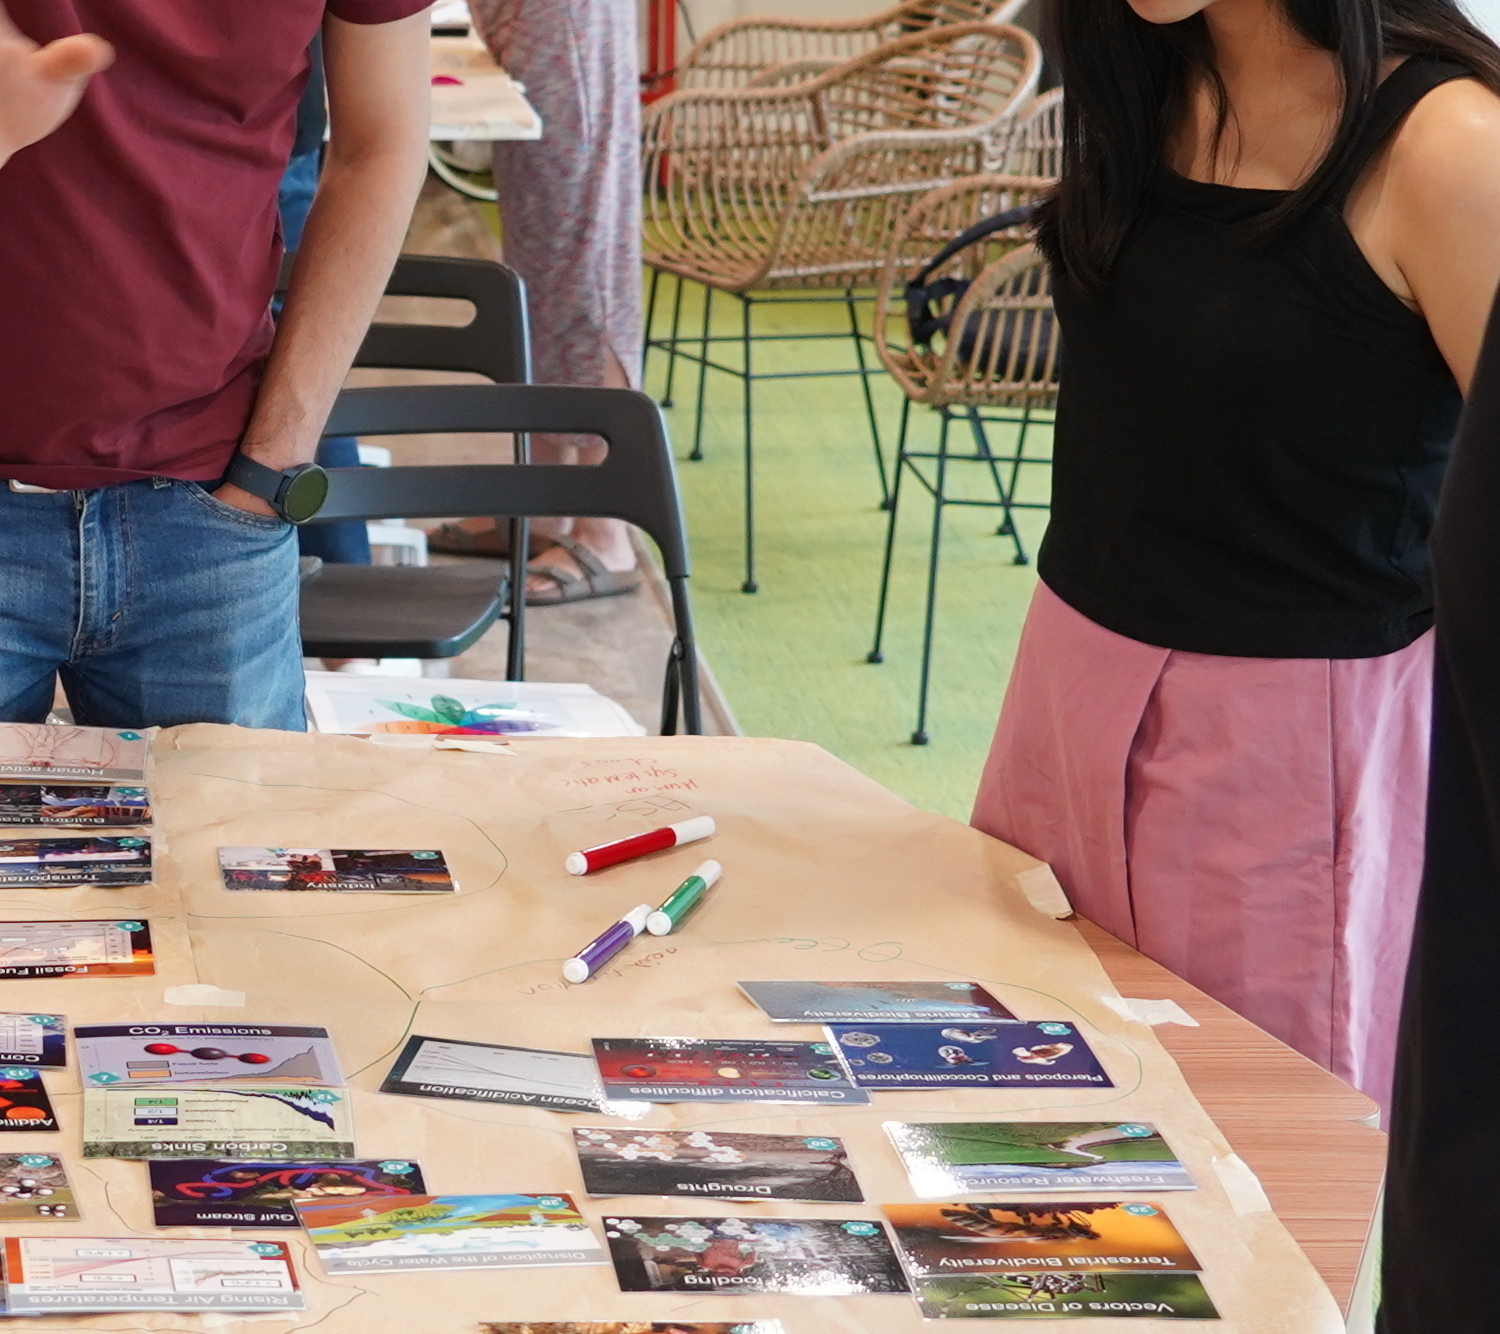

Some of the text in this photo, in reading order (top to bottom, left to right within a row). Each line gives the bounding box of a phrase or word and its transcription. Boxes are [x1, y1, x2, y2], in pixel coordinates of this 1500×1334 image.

[47, 765, 104, 776] Human
[46, 815, 105, 825] Building
[306, 879, 375, 890] Industry
[35, 966, 88, 976] Fossil
[803, 1009, 979, 1019] Marine Biodiversity
[175, 1027, 272, 1035] Emissions
[858, 1071, 1103, 1083] Pteropods and Coccolithophores
[420, 1084, 599, 1109] Ocean Acidification
[630, 1086, 845, 1098] Calcification difficulties
[1125, 1127, 1143, 1135] 31
[152, 1142, 287, 1152] Carbon Sinks
[388, 1163, 405, 1171] 42
[1055, 1173, 1164, 1185] Freshwater
[677, 1181, 771, 1194] Droughts
[542, 1198, 560, 1206] 20
[1130, 1206, 1147, 1214] 25
[196, 1212, 294, 1223] Gulf Stream
[851, 1225, 867, 1233] 26
[346, 1248, 586, 1269] Disruption of the Water Cycle
[939, 1254, 1176, 1268] Terrestrial Biodiversity
[28, 1294, 288, 1305] Rising Air Temperatures
[965, 1299, 1173, 1313] Vectors of Disease
